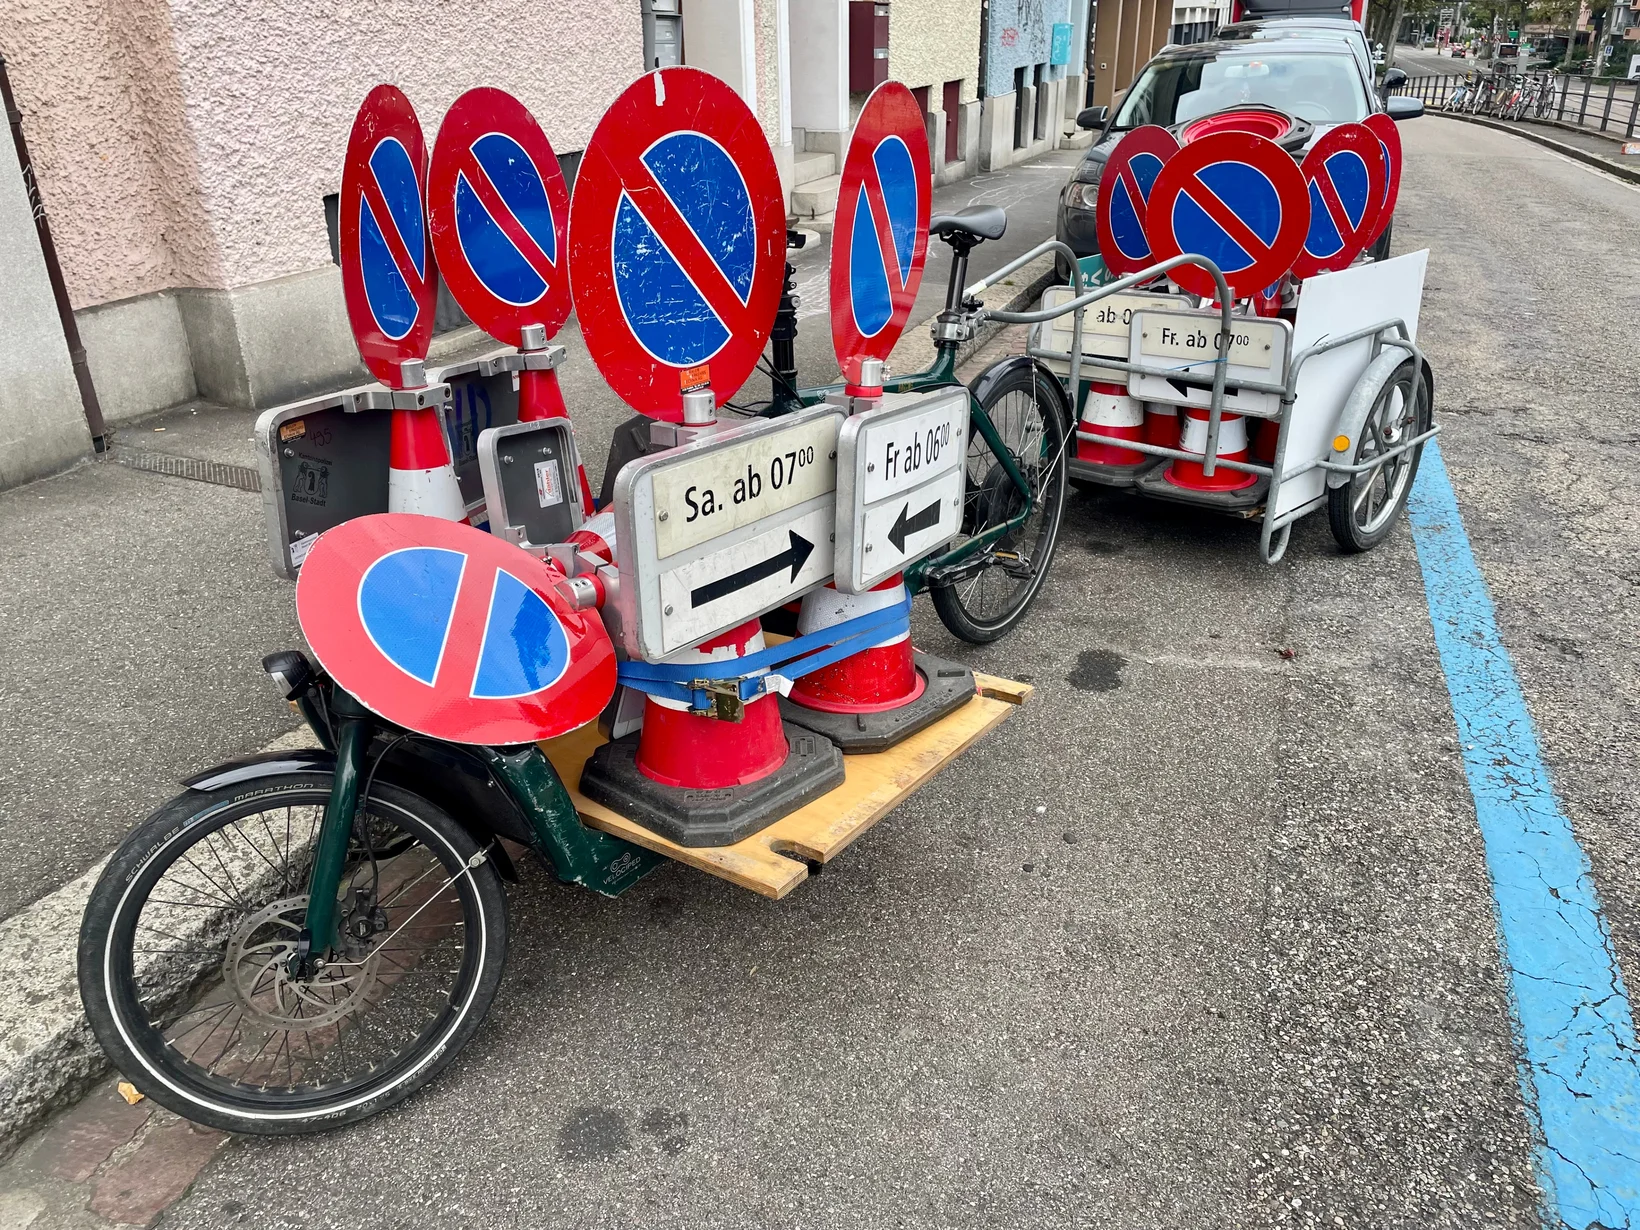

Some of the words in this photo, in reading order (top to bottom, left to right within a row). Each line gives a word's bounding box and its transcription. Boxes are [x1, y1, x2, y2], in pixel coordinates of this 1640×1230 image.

[1096, 306, 1116, 323] ab
[1162, 328, 1179, 345] Fr.
[1186, 330, 1207, 348] ab
[885, 441, 900, 481] Fr
[904, 432, 922, 474] ab
[291, 493, 327, 507] Basel-Stadt
[685, 486, 723, 523] Sa.
[733, 464, 762, 504] ab
[125, 826, 180, 883] SCHWALBE
[234, 783, 314, 802] MARATHON
[603, 857, 640, 884] VELOCIPED
